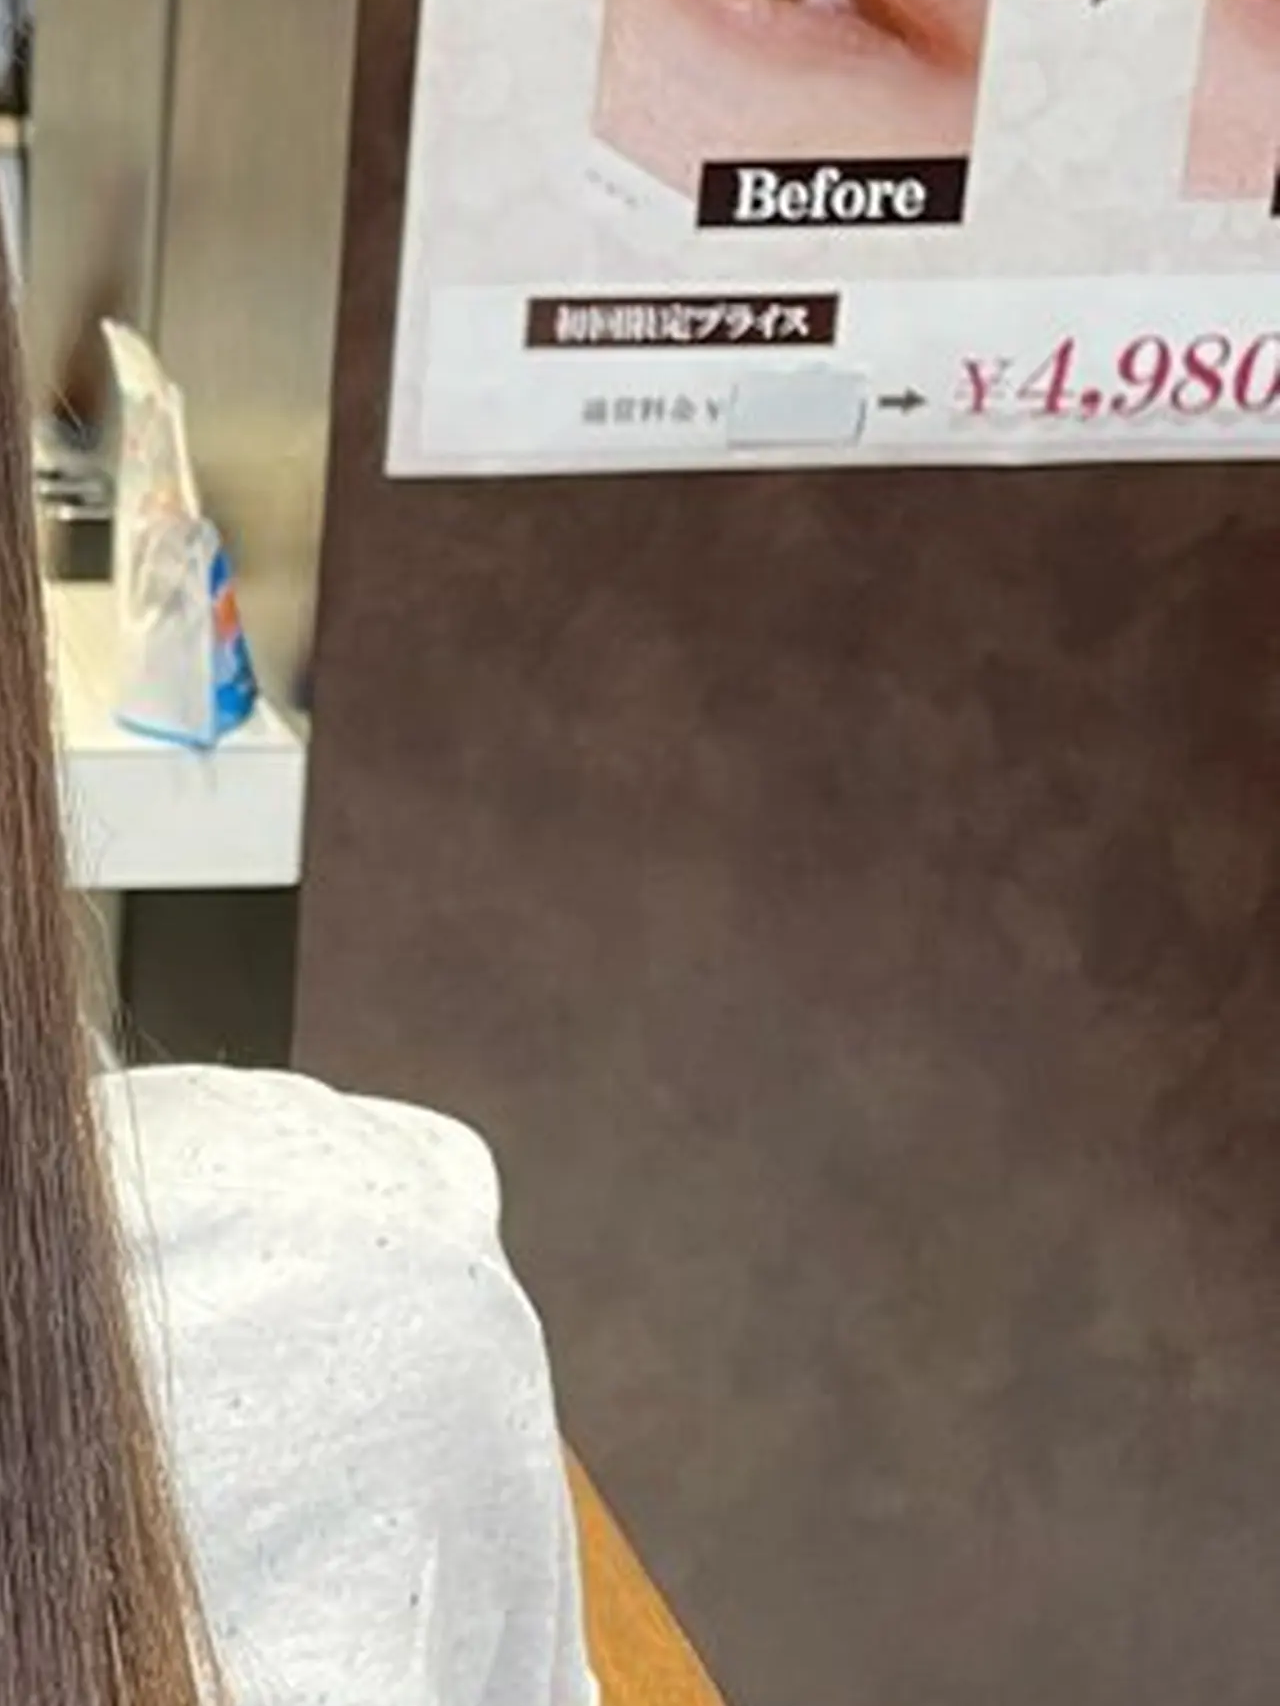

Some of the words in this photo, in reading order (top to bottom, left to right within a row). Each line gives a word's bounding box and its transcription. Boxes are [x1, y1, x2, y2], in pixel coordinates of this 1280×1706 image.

[735, 168, 927, 223] Before
[555, 301, 810, 343] 初回限定プライス
